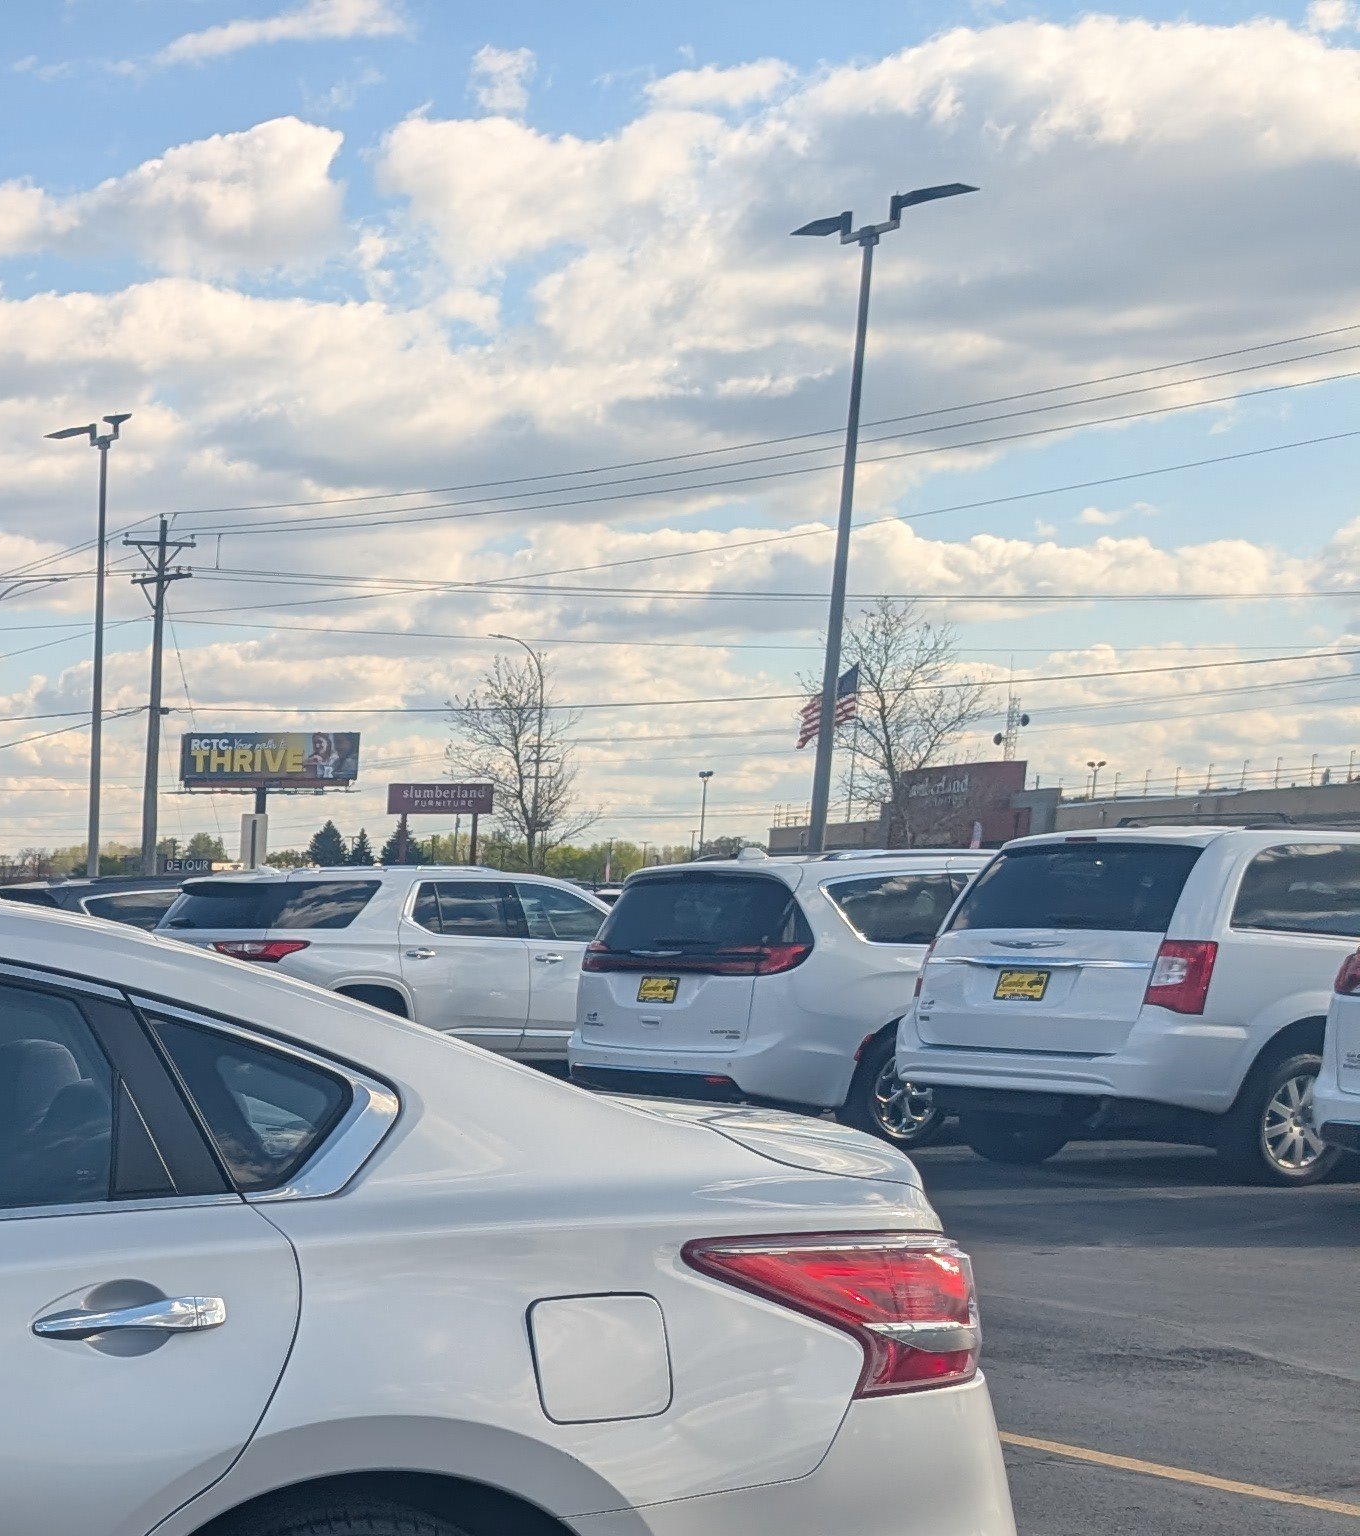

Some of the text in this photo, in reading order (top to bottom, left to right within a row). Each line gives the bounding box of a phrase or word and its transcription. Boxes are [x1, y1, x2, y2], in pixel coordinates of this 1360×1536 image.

[191, 738, 233, 751] RCTC.
[234, 738, 254, 750] Your
[402, 785, 485, 799] slumberland
[414, 799, 474, 808] FURNITURE
[166, 860, 209, 870] DETOUR
